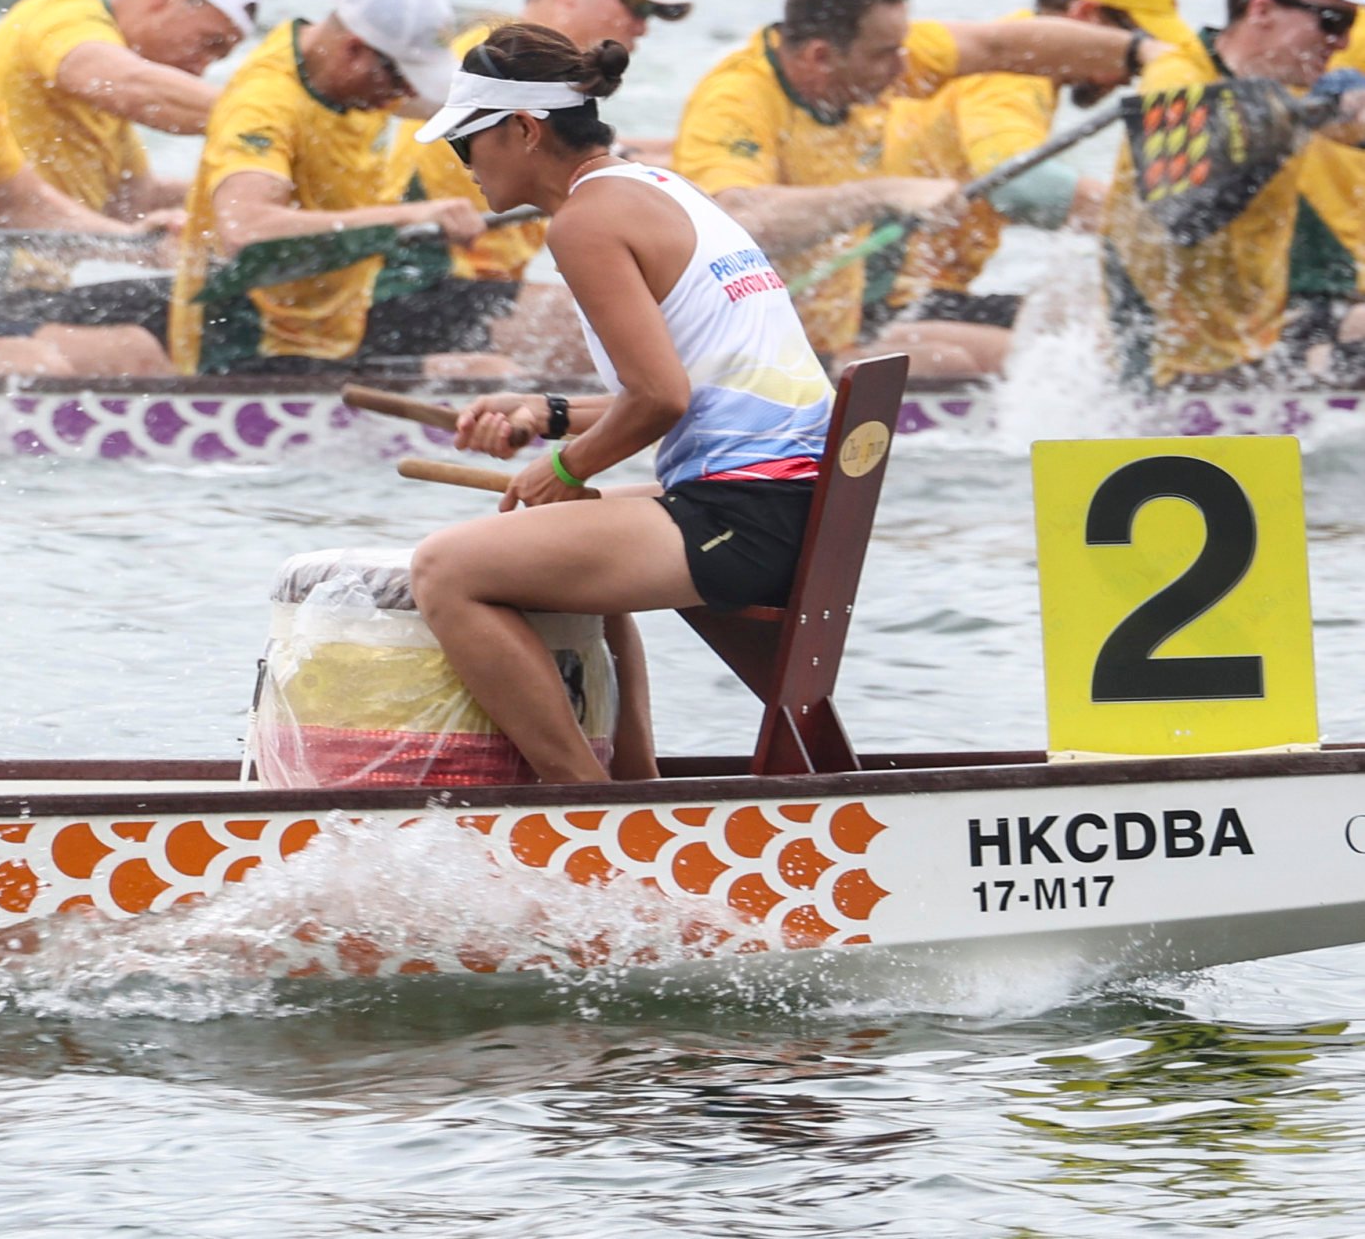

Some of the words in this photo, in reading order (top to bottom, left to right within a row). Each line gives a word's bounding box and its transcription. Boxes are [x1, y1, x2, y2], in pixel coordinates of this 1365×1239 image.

[1085, 455, 1265, 703] 2
[968, 808, 1255, 867] HKCDBA
[972, 875, 1115, 913] 17-M17
